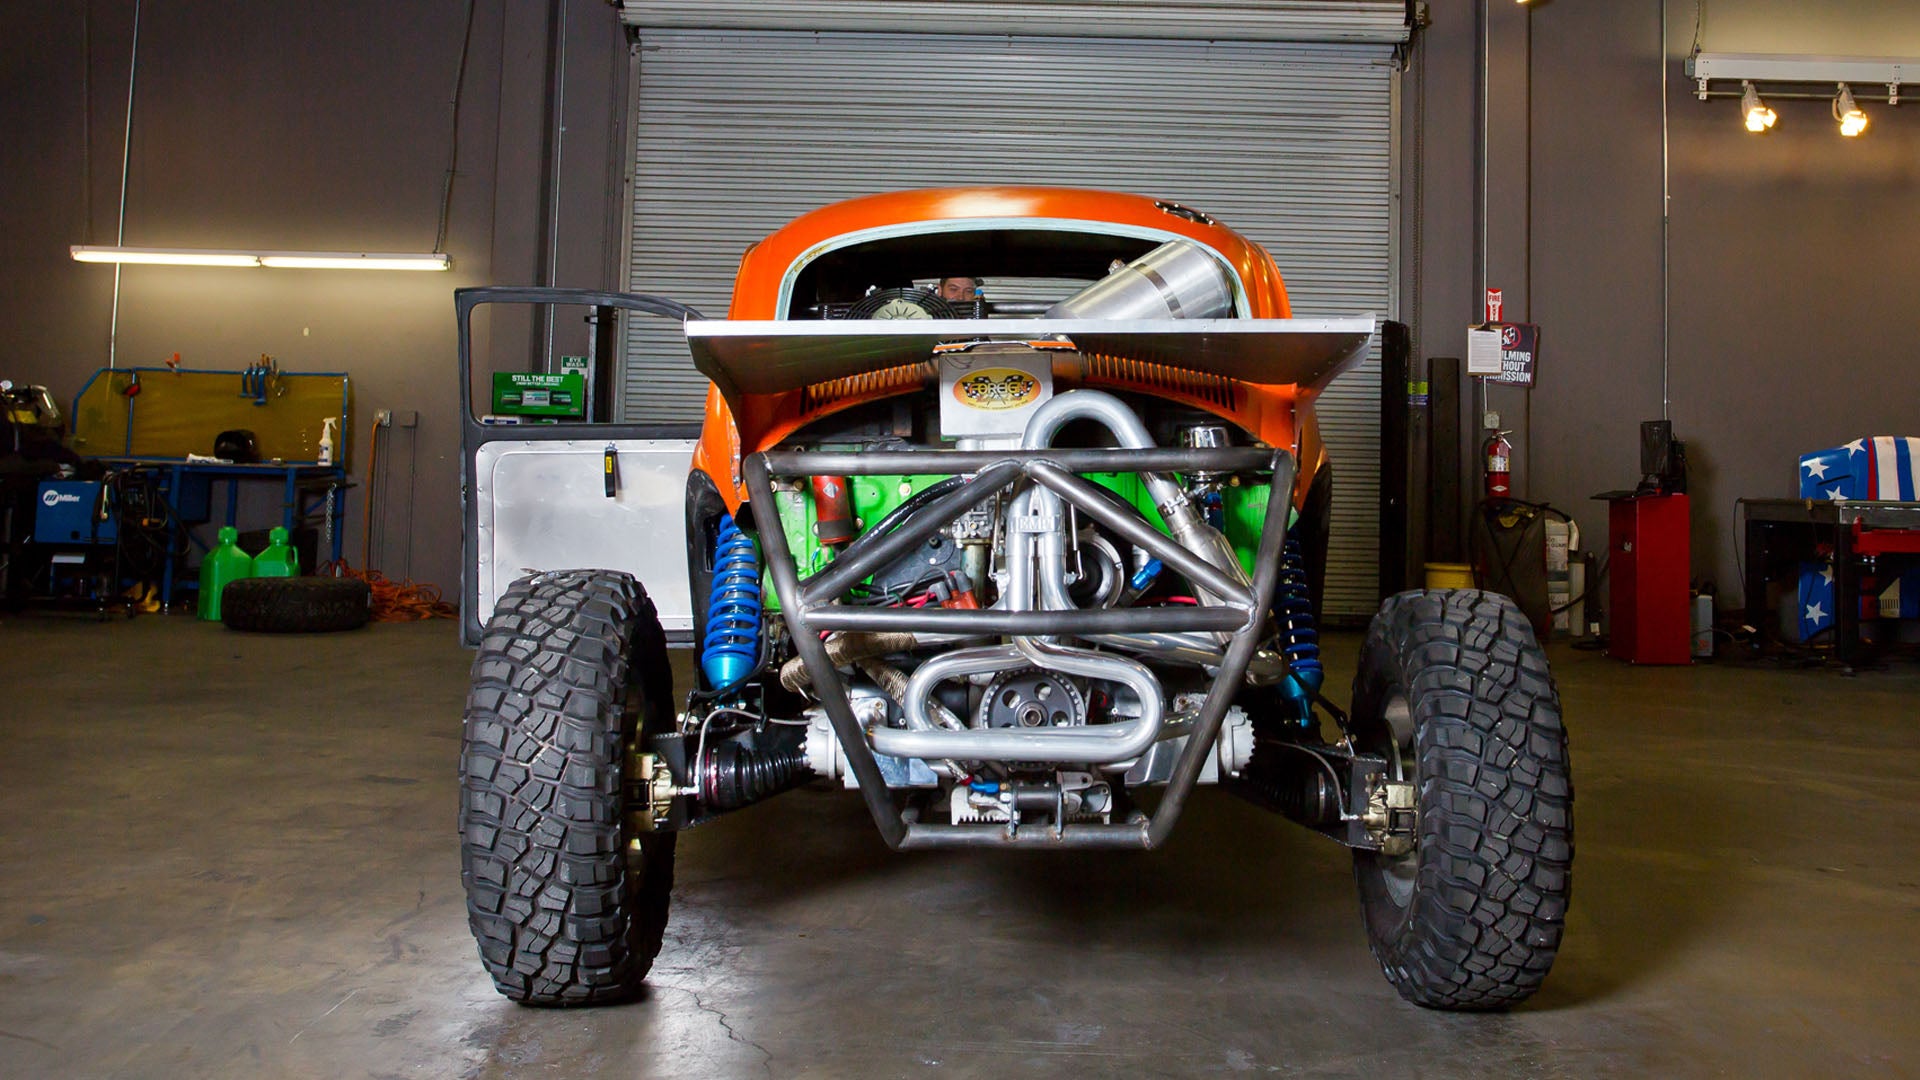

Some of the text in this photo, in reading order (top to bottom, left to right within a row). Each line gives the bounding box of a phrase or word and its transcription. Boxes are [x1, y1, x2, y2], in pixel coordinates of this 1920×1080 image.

[1502, 350, 1531, 362] ILMING
[1502, 361, 1526, 372] HOUT
[546, 375, 564, 383] BEST
[969, 382, 1027, 394] FOREIGN
[58, 494, 80, 502] Miller
